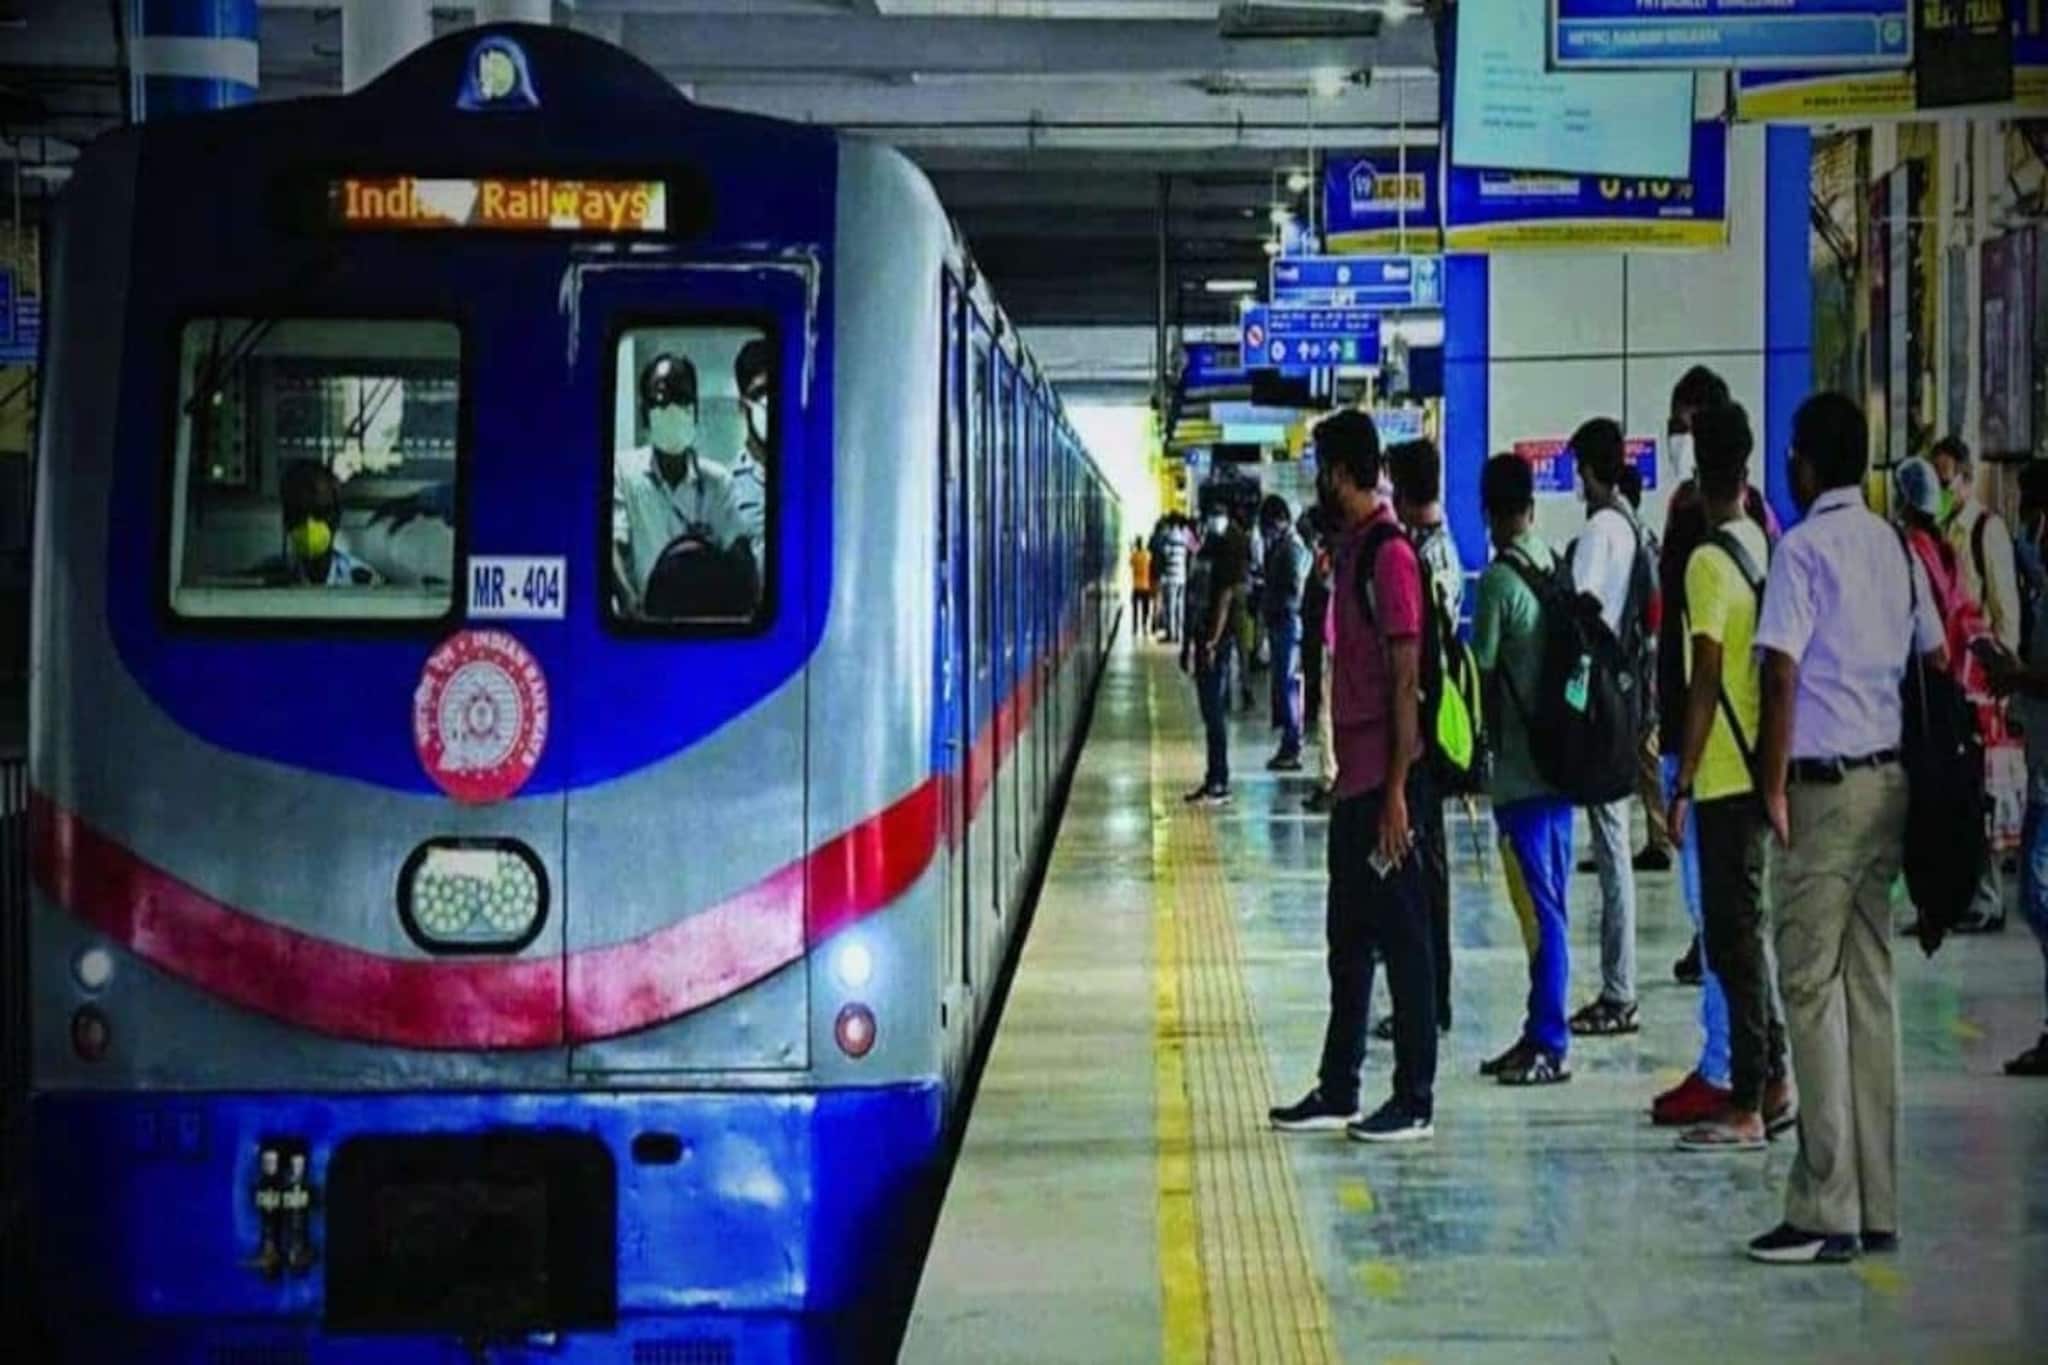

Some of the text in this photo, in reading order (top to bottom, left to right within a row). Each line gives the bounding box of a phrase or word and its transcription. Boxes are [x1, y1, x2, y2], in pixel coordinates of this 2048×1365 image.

[482, 179, 650, 230] Railways
[473, 565, 504, 608] MR
[522, 565, 560, 608] 404
